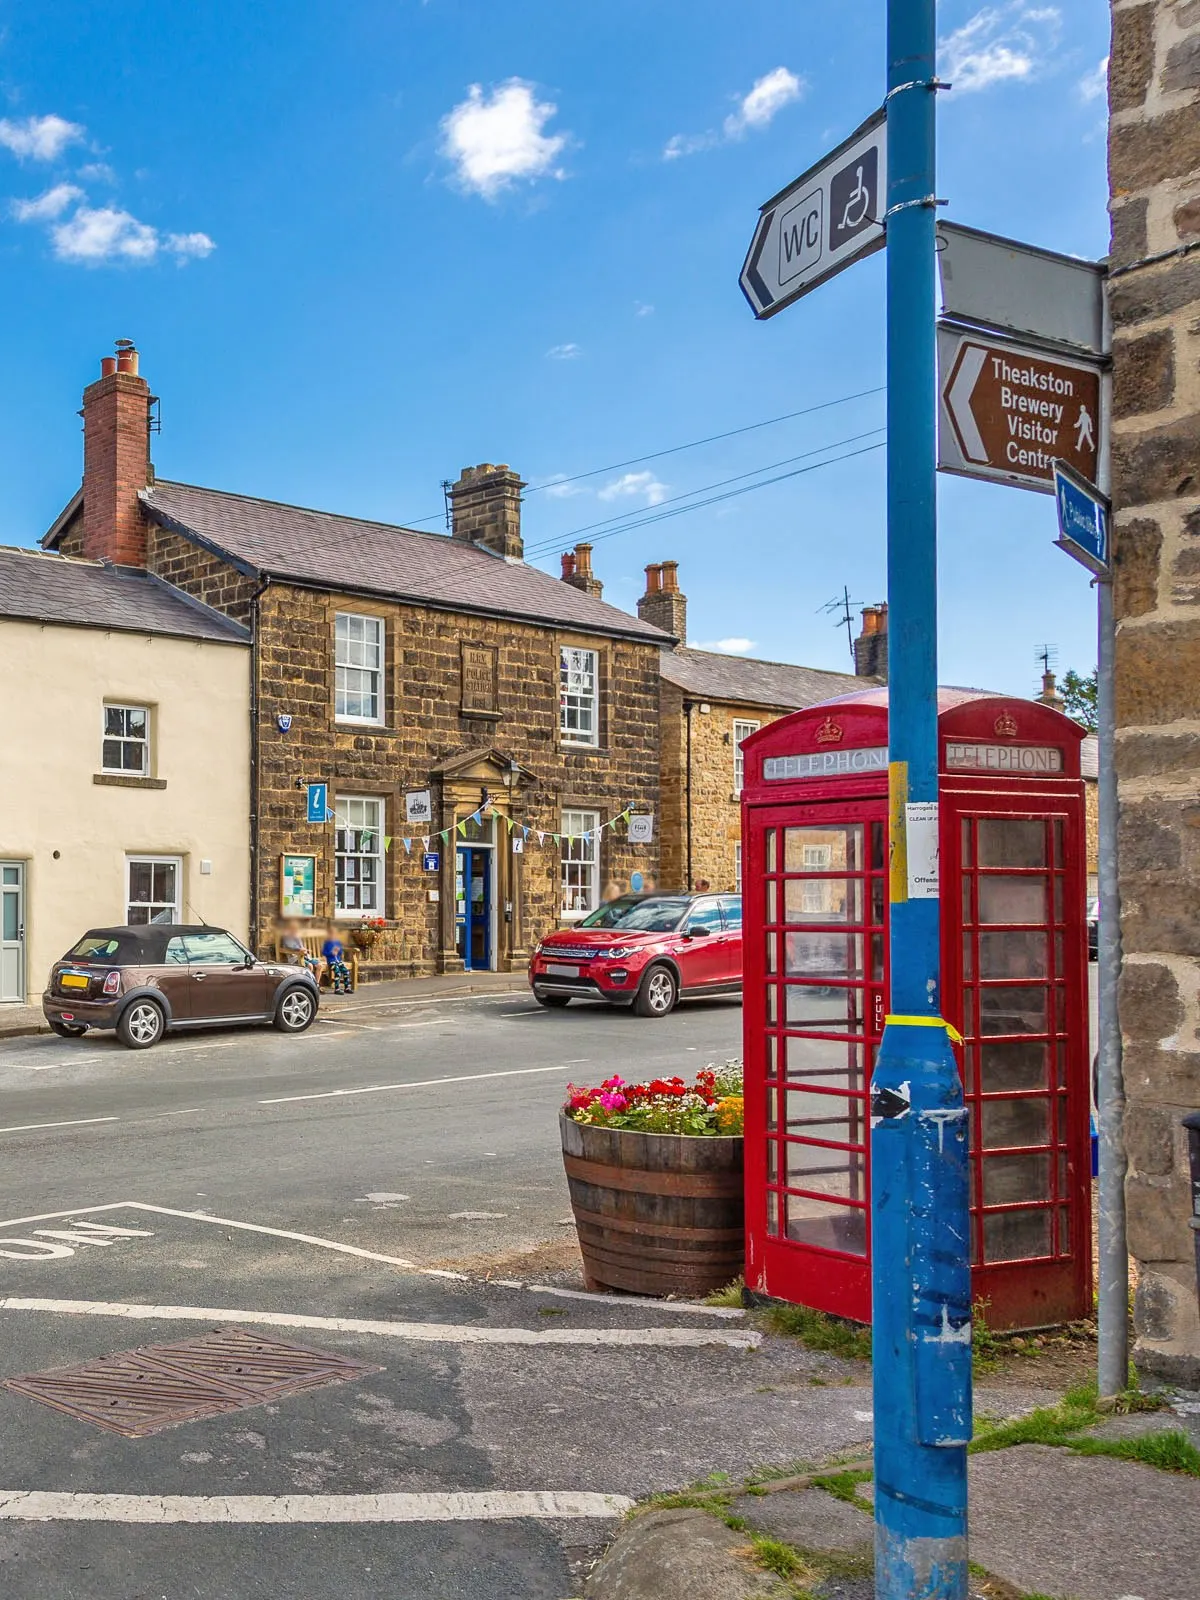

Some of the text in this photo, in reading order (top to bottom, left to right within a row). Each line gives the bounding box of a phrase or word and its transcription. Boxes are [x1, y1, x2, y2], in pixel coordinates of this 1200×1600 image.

[783, 209, 819, 263] WC
[991, 357, 1073, 397] Theakston
[1001, 386, 1064, 424] Brewery
[1007, 414, 1058, 445] Visitor
[950, 746, 1058, 770] TELEPHONE
